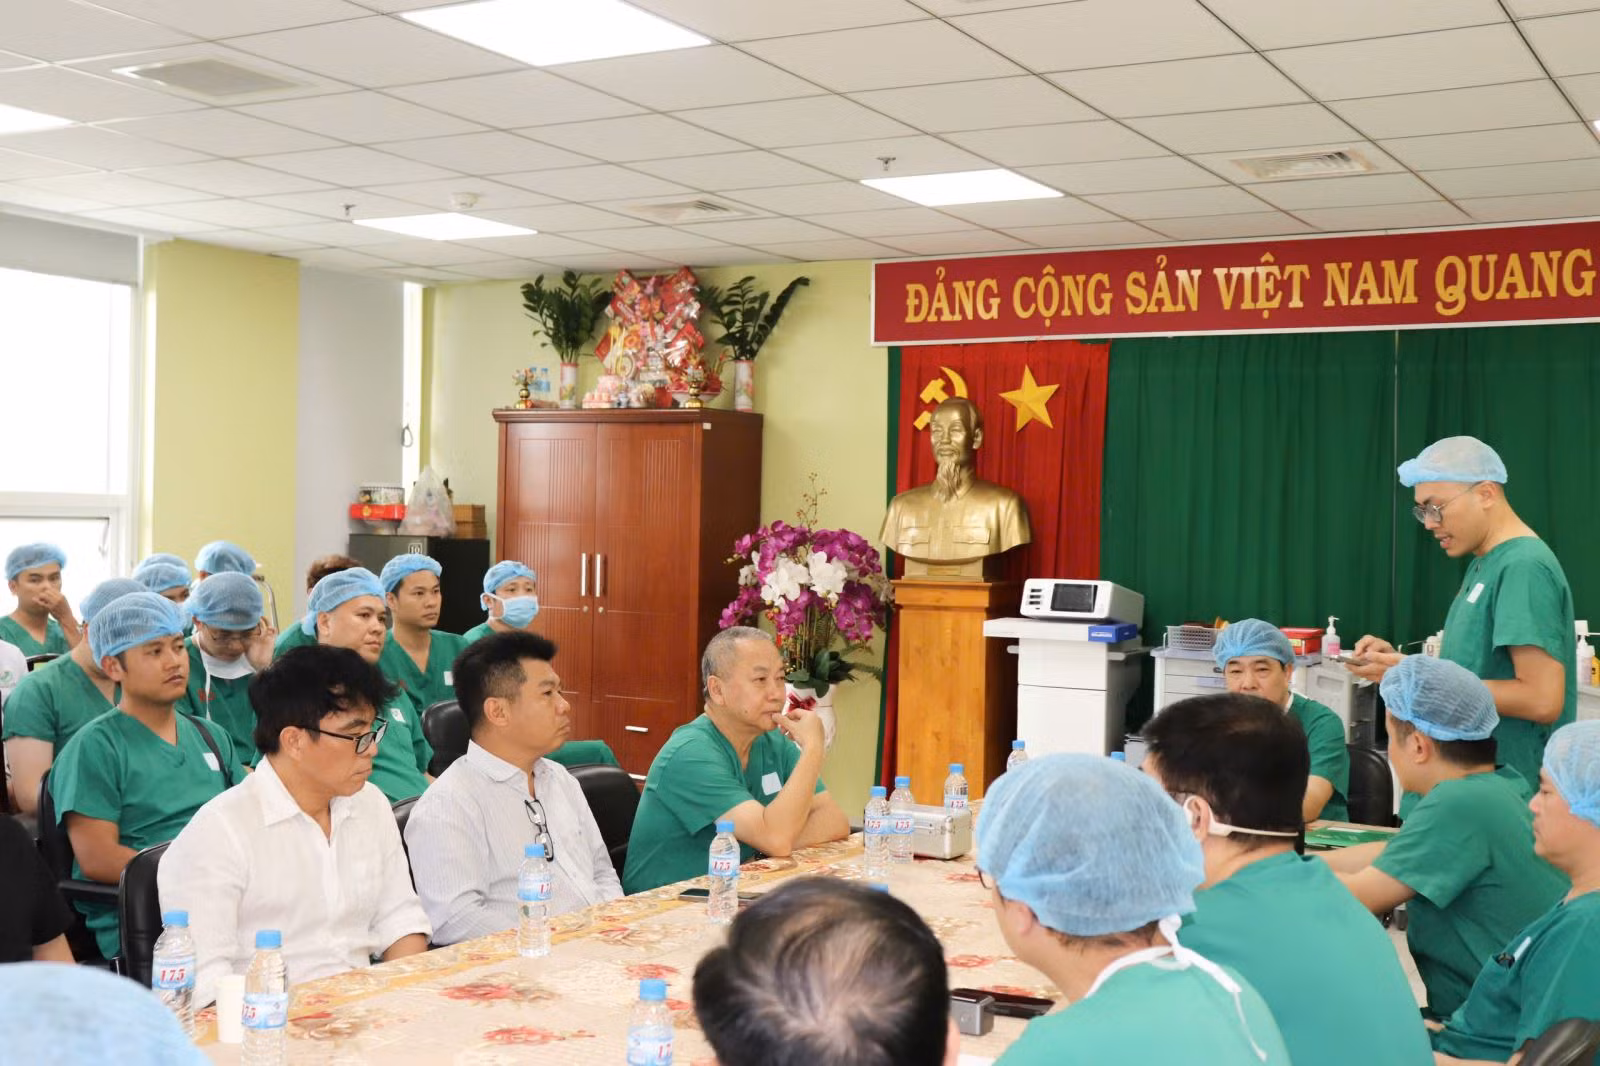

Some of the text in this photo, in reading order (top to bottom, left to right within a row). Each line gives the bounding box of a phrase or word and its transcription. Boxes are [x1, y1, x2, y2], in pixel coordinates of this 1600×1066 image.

[904, 248, 1597, 328] ĐẢNG CỘNG SẢN VIỆT NAM QUANG
[951, 800, 965, 809] 175
[867, 820, 881, 829] 175
[895, 820, 911, 829] 175
[713, 861, 731, 871] 175
[160, 968, 185, 982] 175
